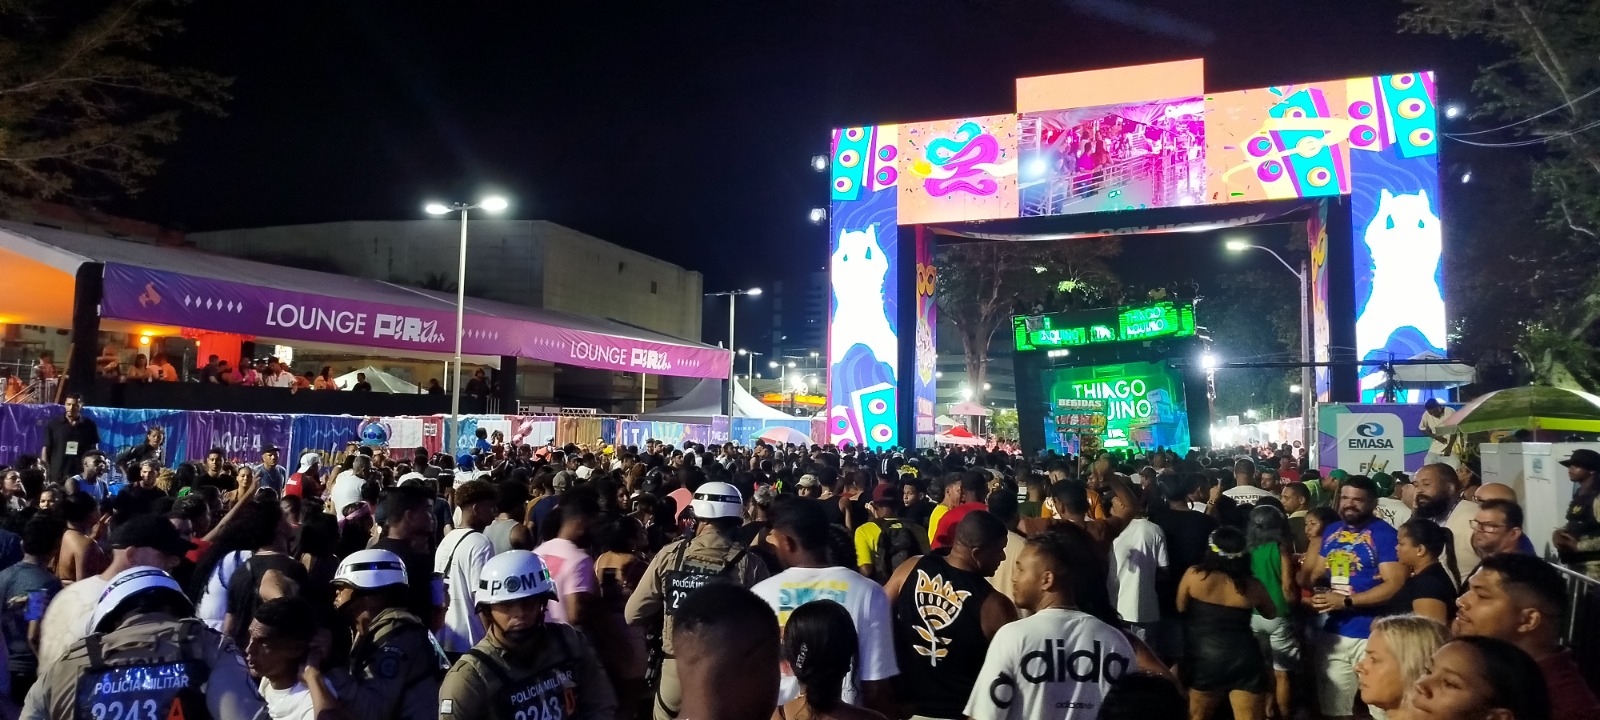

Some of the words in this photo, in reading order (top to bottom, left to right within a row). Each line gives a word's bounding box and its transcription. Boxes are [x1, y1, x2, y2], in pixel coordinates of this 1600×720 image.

[266, 302, 367, 335] LOUNGE
[570, 341, 627, 365] LOUNGE
[1072, 379, 1146, 399] THIAGO
[1348, 438, 1394, 449] EMASA
